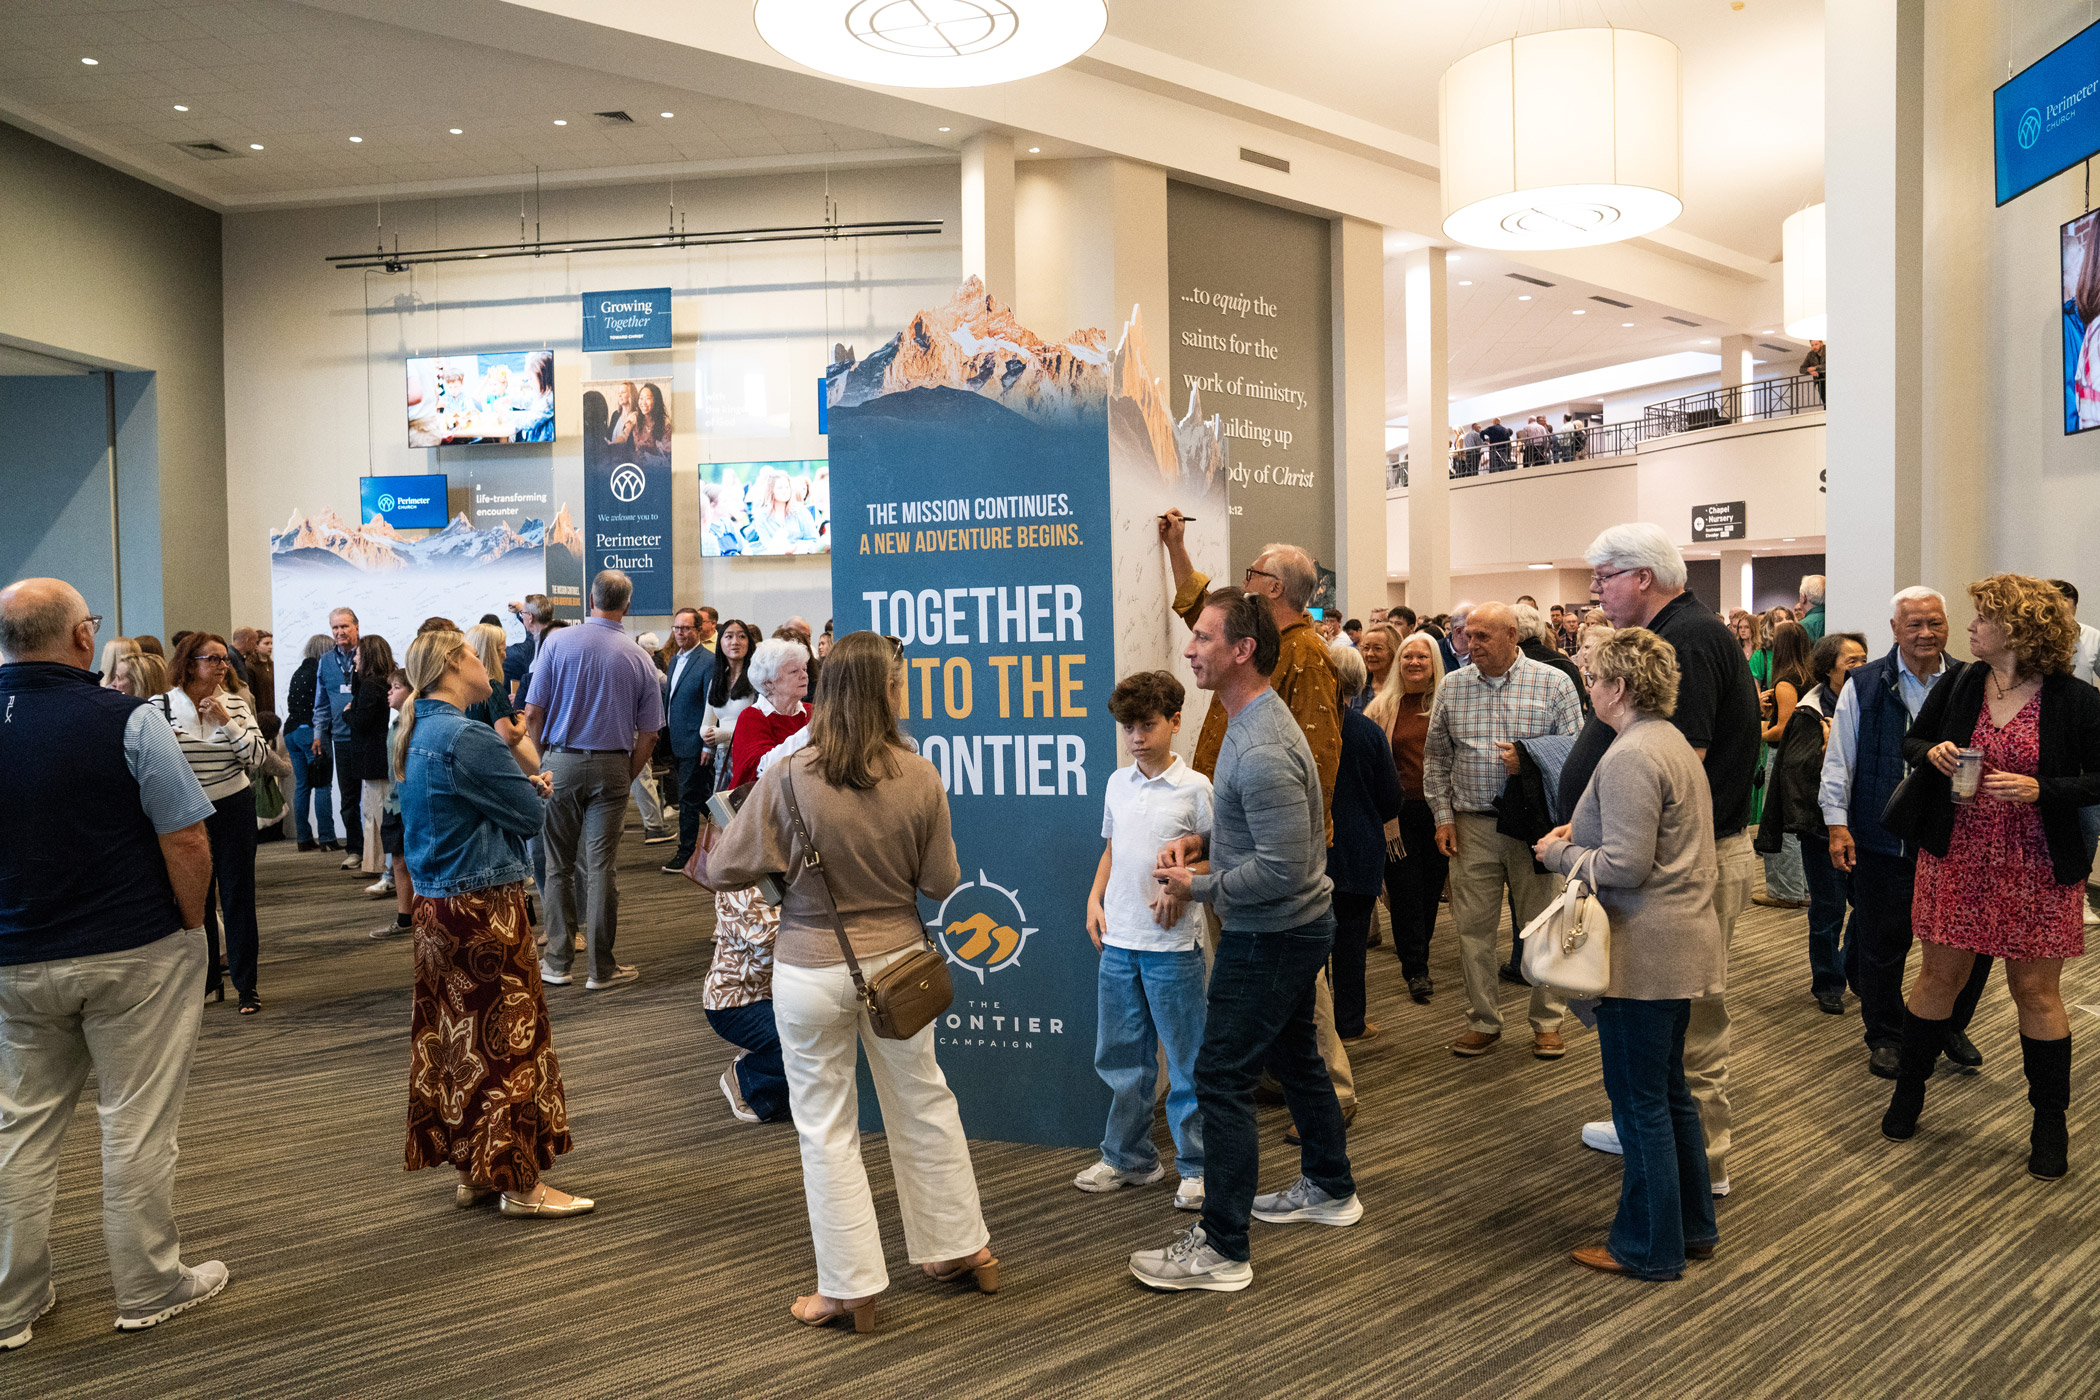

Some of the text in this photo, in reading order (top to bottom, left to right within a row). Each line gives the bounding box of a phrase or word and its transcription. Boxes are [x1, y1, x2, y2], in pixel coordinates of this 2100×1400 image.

[2046, 80, 2099, 121] Perimeter
[2046, 109, 2076, 132] CHURCH
[601, 300, 653, 315] Growing
[1213, 292, 1251, 318] equip
[1253, 296, 1277, 318] the
[604, 315, 650, 332] Together
[1181, 329, 1278, 360] saints for the
[1183, 372, 1307, 410] work of ministry,
[1223, 417, 1272, 448] uilding
[1274, 428, 1292, 449] up
[1228, 462, 1314, 488] ody of Christ
[397, 496, 431, 505] Perimeter
[476, 492, 548, 503] life-transforming
[476, 507, 519, 516] encounter
[598, 514, 610, 522] We
[637, 514, 650, 523] you
[866, 493, 1074, 525] THE MISSION CONTINUES.
[1708, 505, 1730, 515] Chapel
[1708, 515, 1734, 523] Nursery
[596, 533, 662, 547] Perimeter
[859, 523, 1084, 555] A NEW ADVENTURE BEGINS.
[603, 553, 654, 569] Church
[862, 584, 1084, 646] TOGETHER
[899, 653, 1088, 719] TO THE
[4, 695, 16, 723] RLX
[912, 734, 1088, 796] ONTIER
[968, 1000, 1000, 1009] THE
[934, 1013, 1063, 1034] ONTIER
[939, 1037, 1032, 1049] CAMPAIGN
